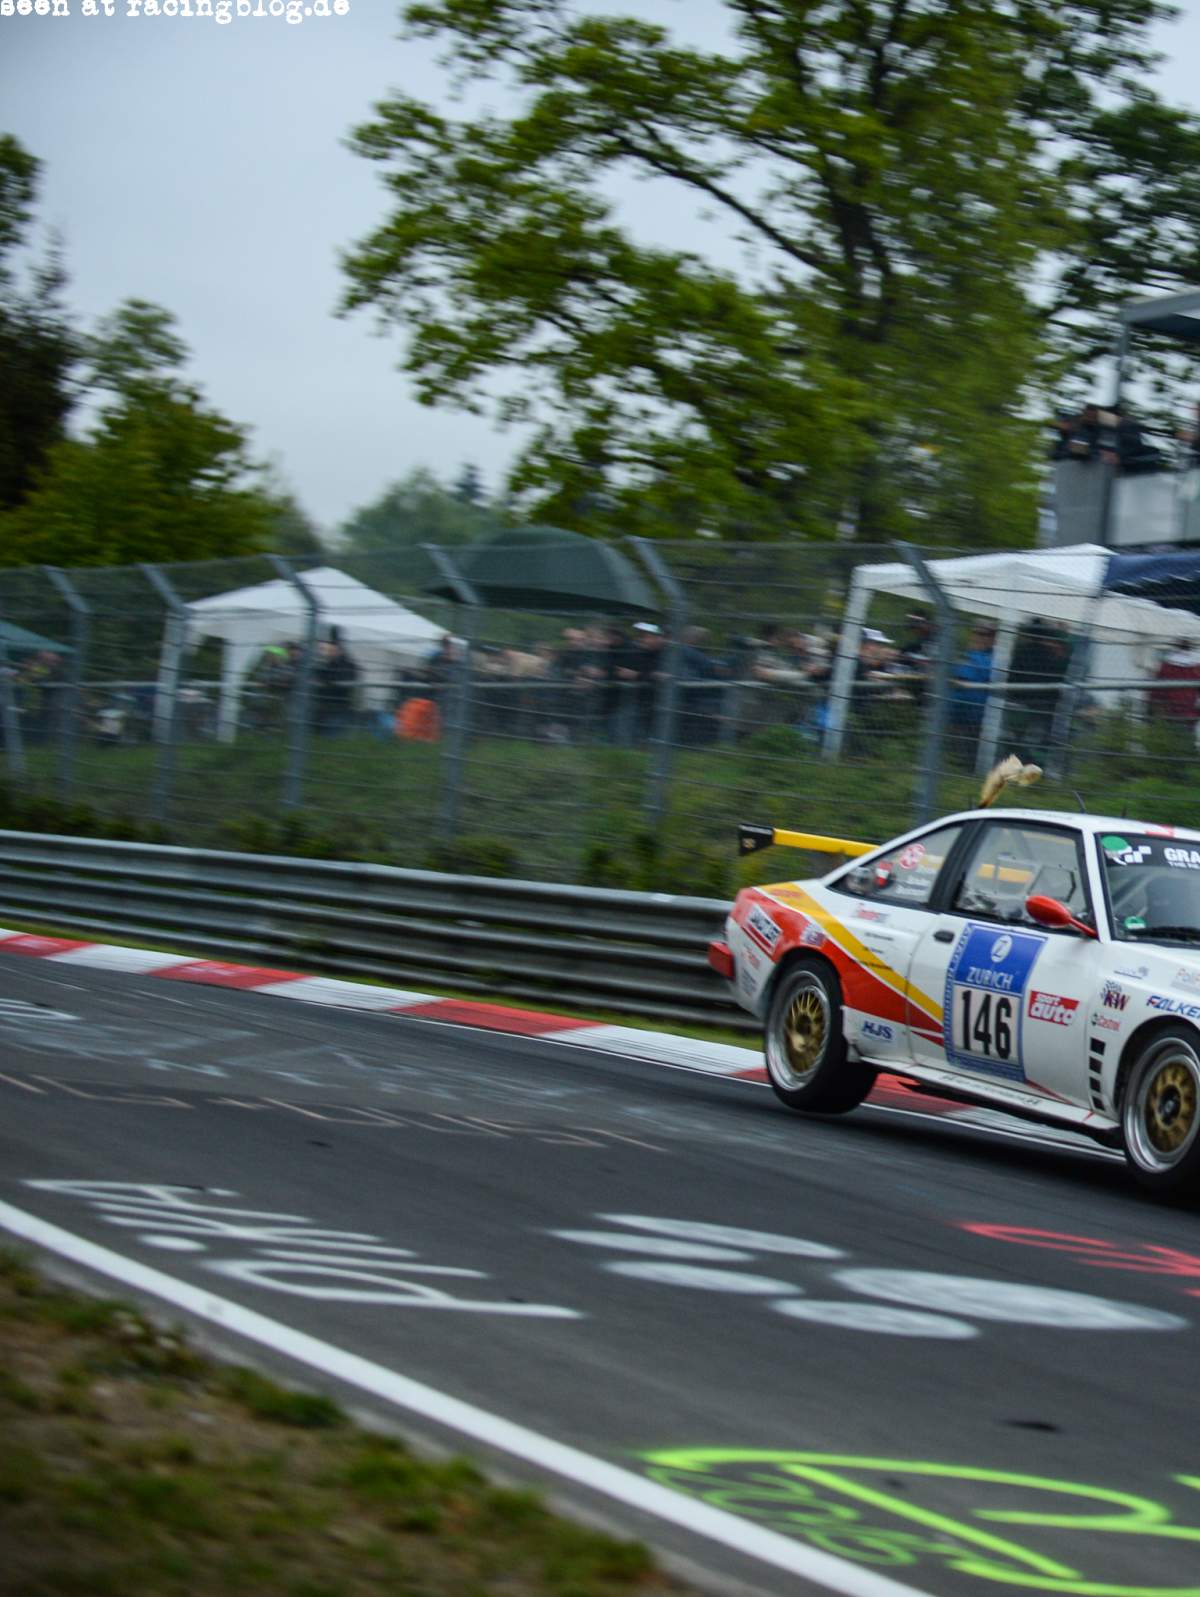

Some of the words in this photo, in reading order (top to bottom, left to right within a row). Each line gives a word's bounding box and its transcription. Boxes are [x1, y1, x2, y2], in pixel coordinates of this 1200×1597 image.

[966, 966, 1014, 990] ZURICH
[962, 990, 1012, 1060] 146
[1031, 1002, 1076, 1025] auto
[862, 1020, 893, 1040] HJS
